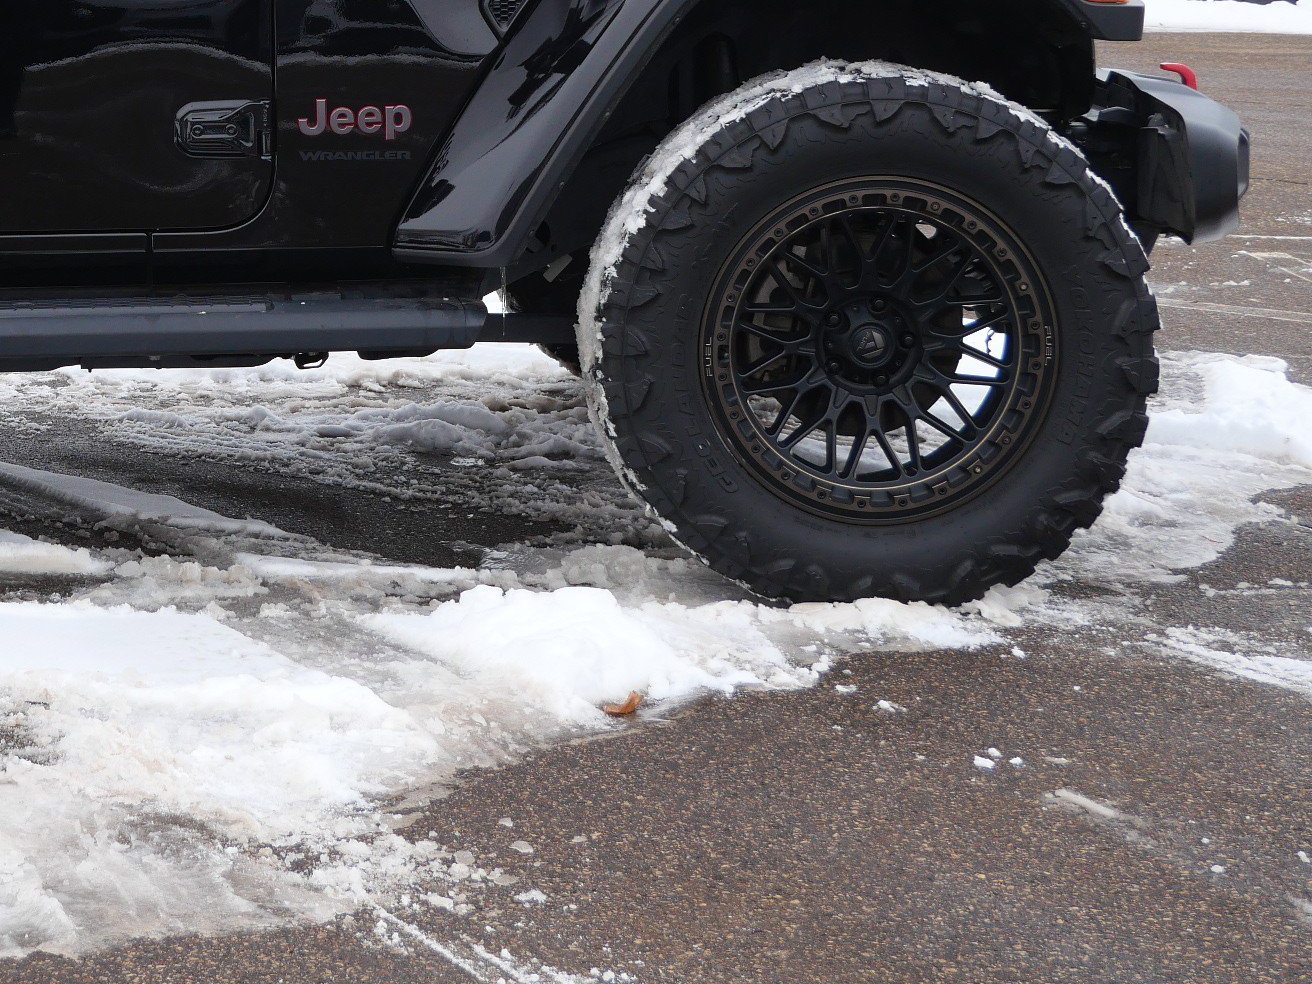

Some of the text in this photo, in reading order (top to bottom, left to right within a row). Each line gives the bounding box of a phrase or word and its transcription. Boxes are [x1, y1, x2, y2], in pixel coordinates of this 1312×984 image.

[297, 98, 412, 141] Jeep
[298, 149, 411, 161] WRANGLER
[705, 336, 713, 377] FUEL
[1044, 325, 1053, 366] FUEL
